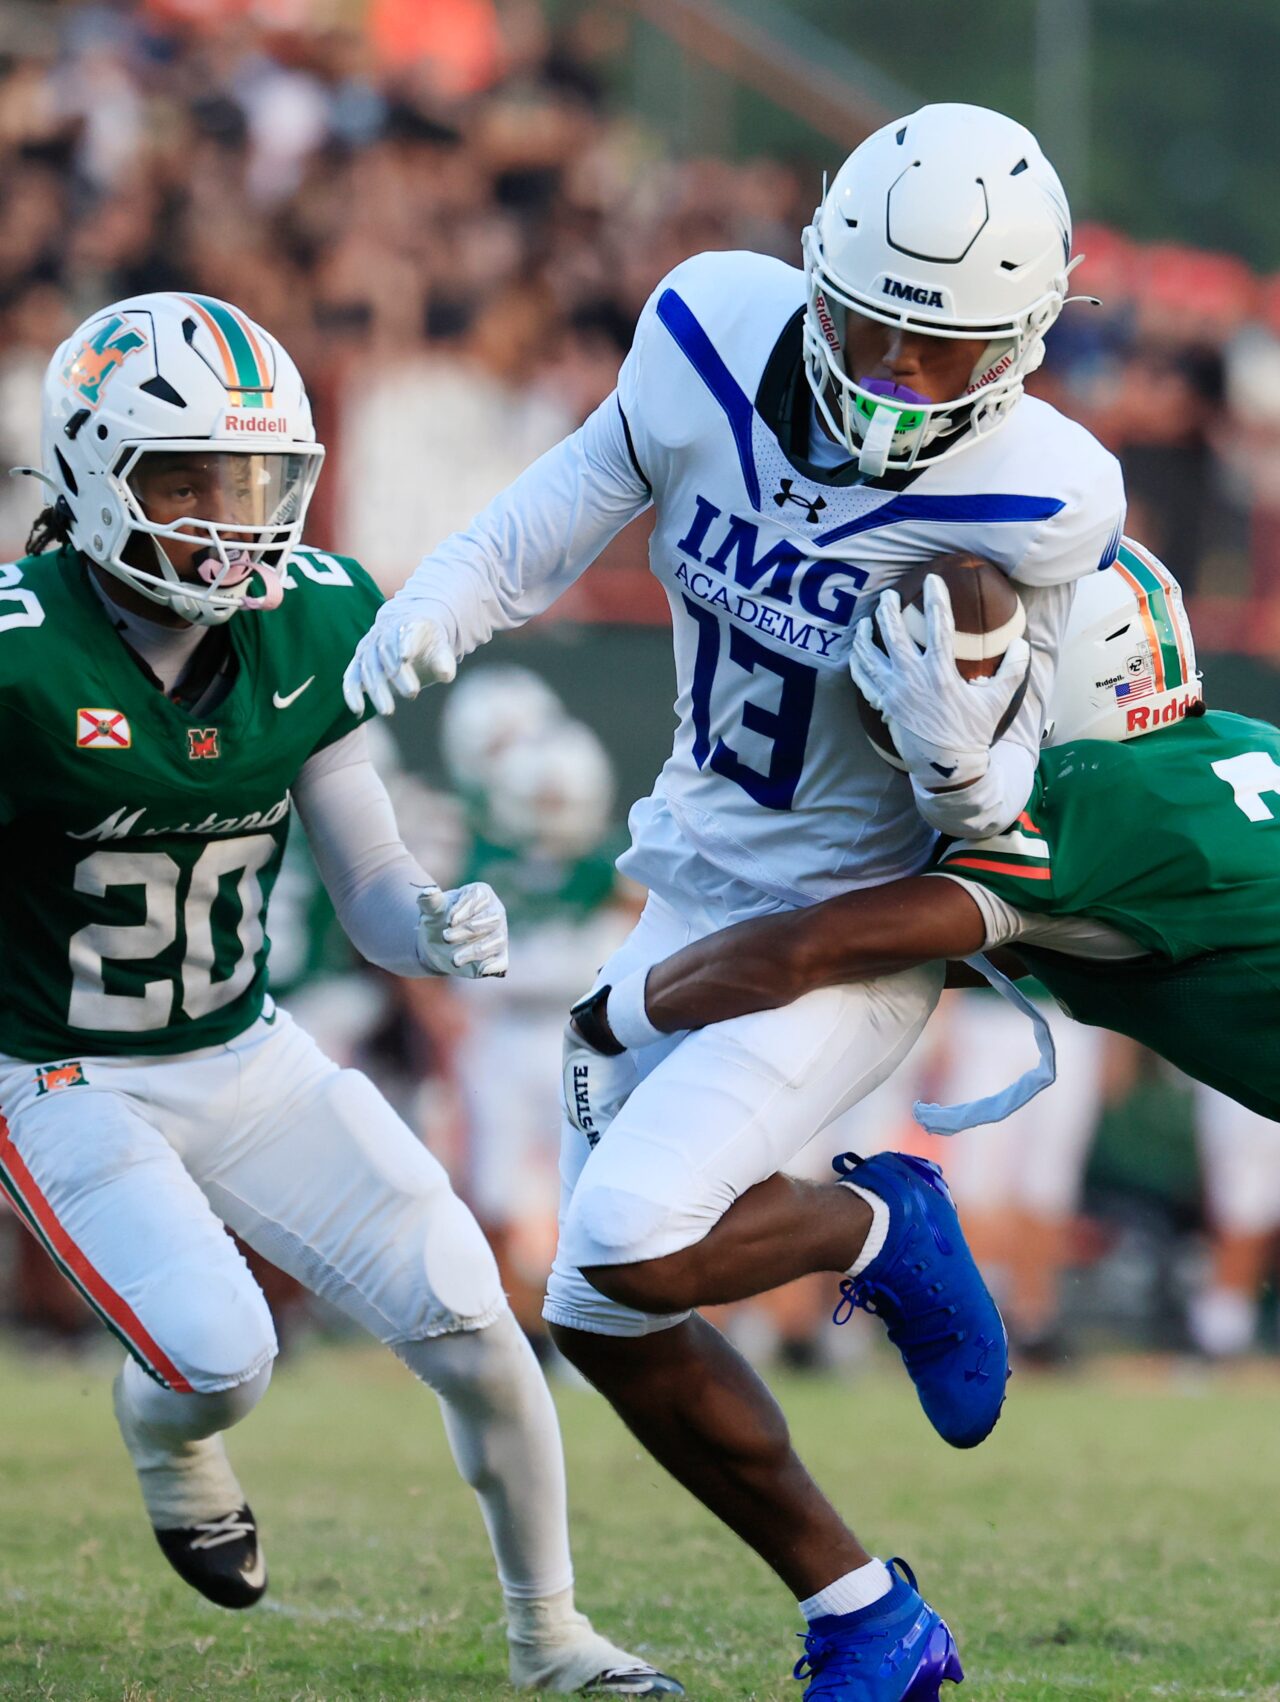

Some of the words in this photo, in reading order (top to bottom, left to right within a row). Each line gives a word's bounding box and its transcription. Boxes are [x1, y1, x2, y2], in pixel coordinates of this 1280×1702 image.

[815, 296, 841, 351] Riddell
[881, 277, 944, 309] IMGA
[966, 356, 1012, 395] Riddell
[225, 415, 287, 433] Riddell
[676, 494, 870, 626] IMG
[673, 562, 842, 657] ACADEMY
[681, 591, 819, 811] 13
[67, 833, 278, 1032] 20
[574, 1065, 594, 1131] STATE
